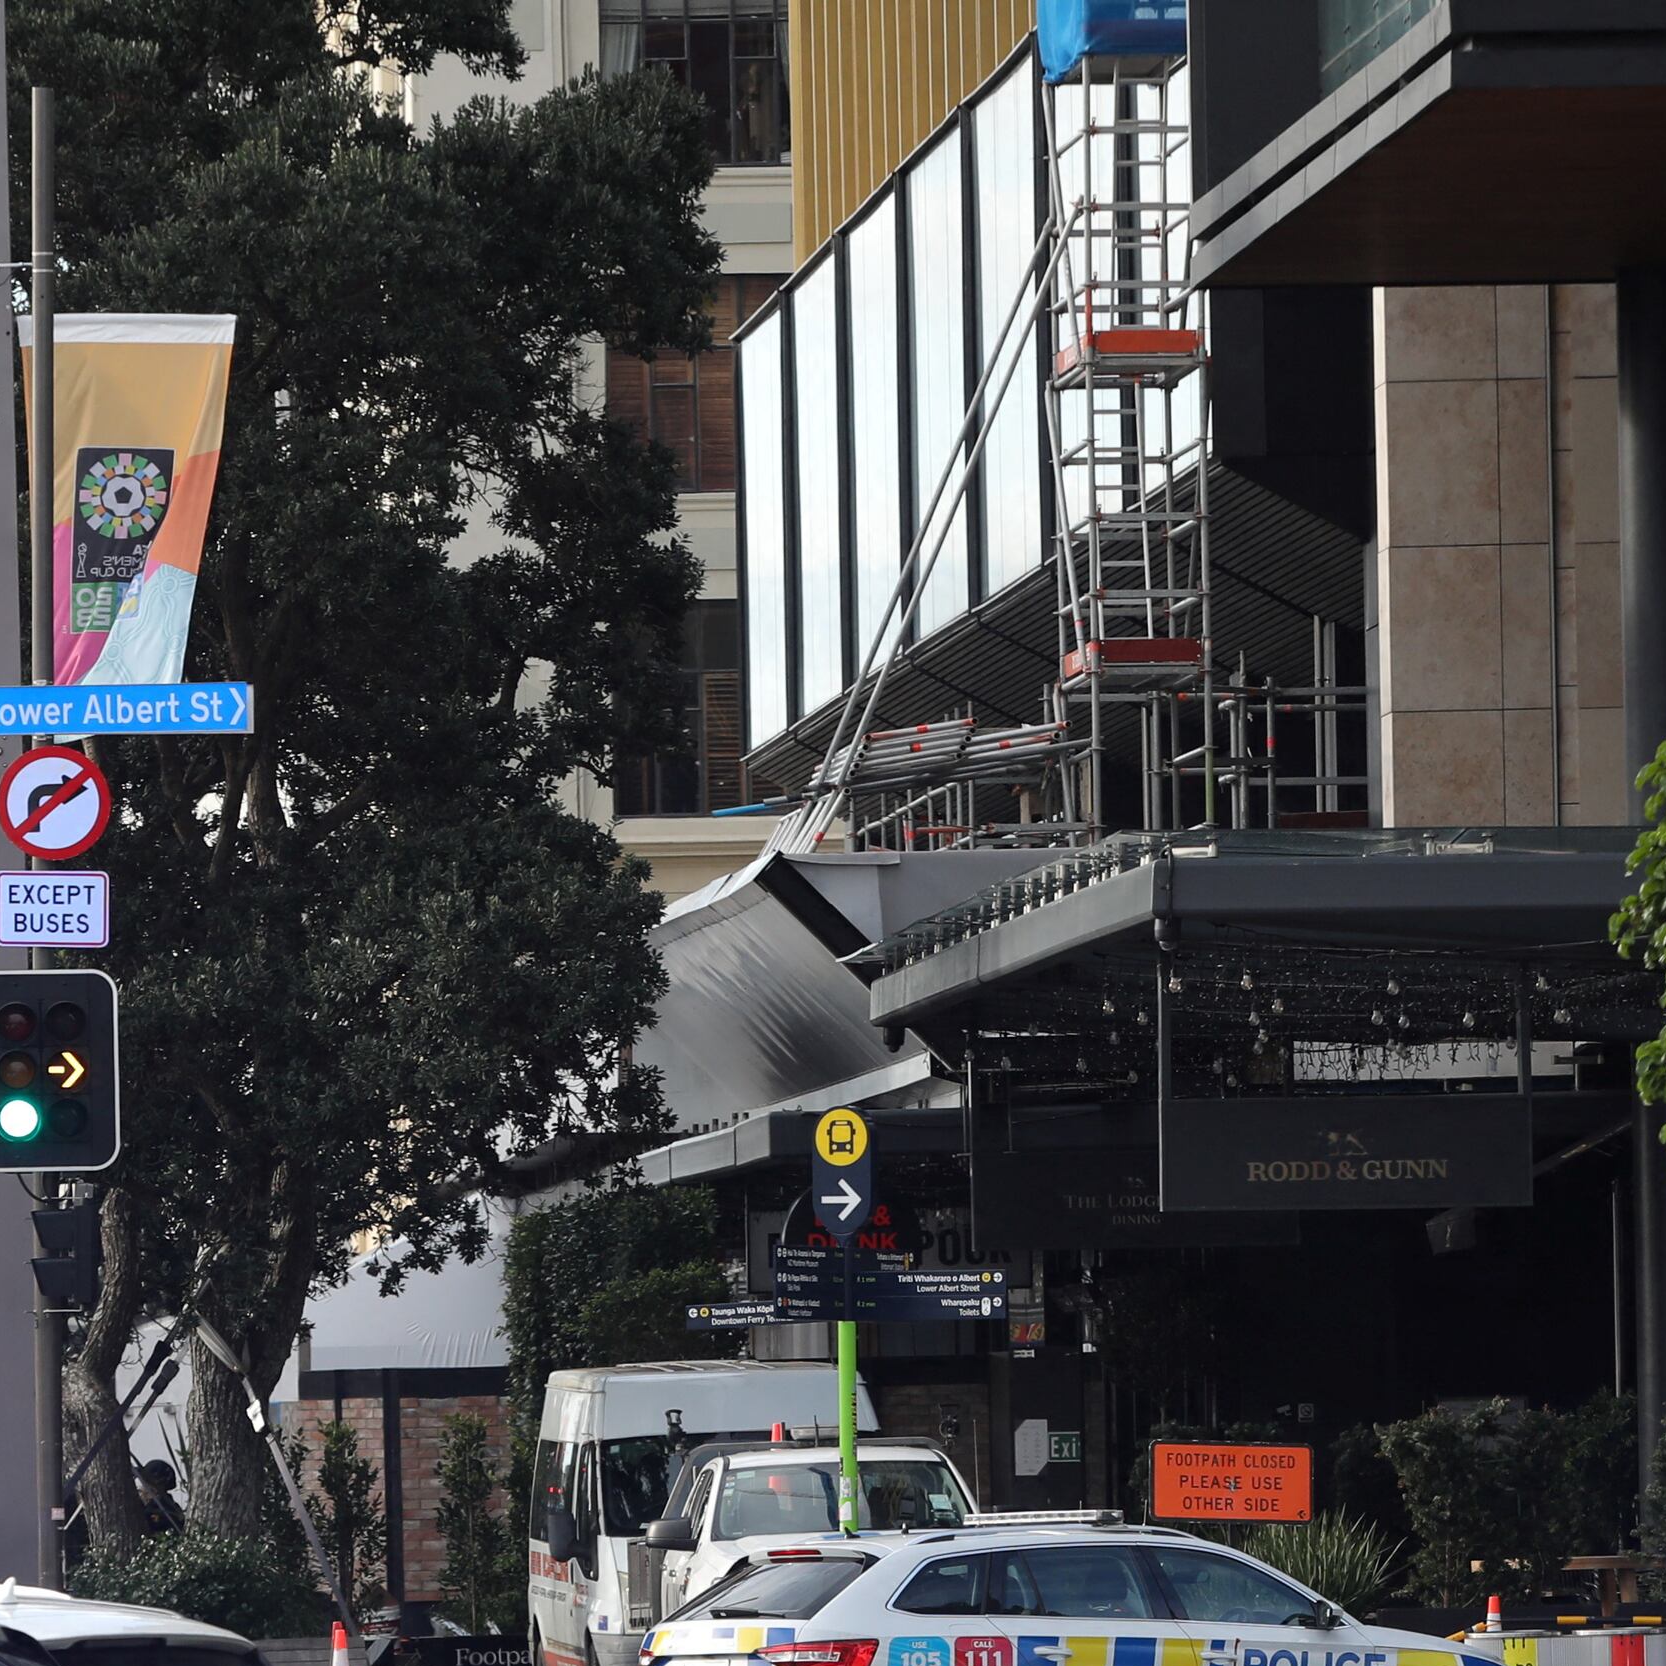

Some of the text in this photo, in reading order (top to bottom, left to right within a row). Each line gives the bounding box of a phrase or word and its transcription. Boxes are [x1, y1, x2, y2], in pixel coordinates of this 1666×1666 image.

[83, 692, 180, 726] Albert
[191, 690, 223, 723] St
[8, 884, 96, 905] EXCEPT
[14, 914, 90, 934] BUSES
[1247, 1159, 1449, 1181] RODD & GUNN
[1061, 1192, 1159, 1210] THE LODG
[872, 1204, 892, 1228] &
[1111, 1215, 1163, 1225] DINING
[915, 1274, 951, 1283] Whakararo
[958, 1274, 980, 1282] Albert
[916, 1284, 980, 1293] Lower Albert Street
[711, 1306, 735, 1317] Taunga
[736, 1305, 756, 1315] Waka
[940, 1299, 980, 1308] Wharepaku
[711, 1316, 747, 1326] Downtown
[747, 1315, 765, 1325] Ferry
[958, 1308, 980, 1317] Toilets
[1051, 1436, 1080, 1458] Exi
[1166, 1452, 1296, 1469] FOOTPATH CLOSED
[1179, 1474, 1283, 1491] PLEASE USE
[1182, 1496, 1280, 1512] OTHER SIDE
[912, 1641, 928, 1649] USE
[973, 1640, 993, 1648] CALL
